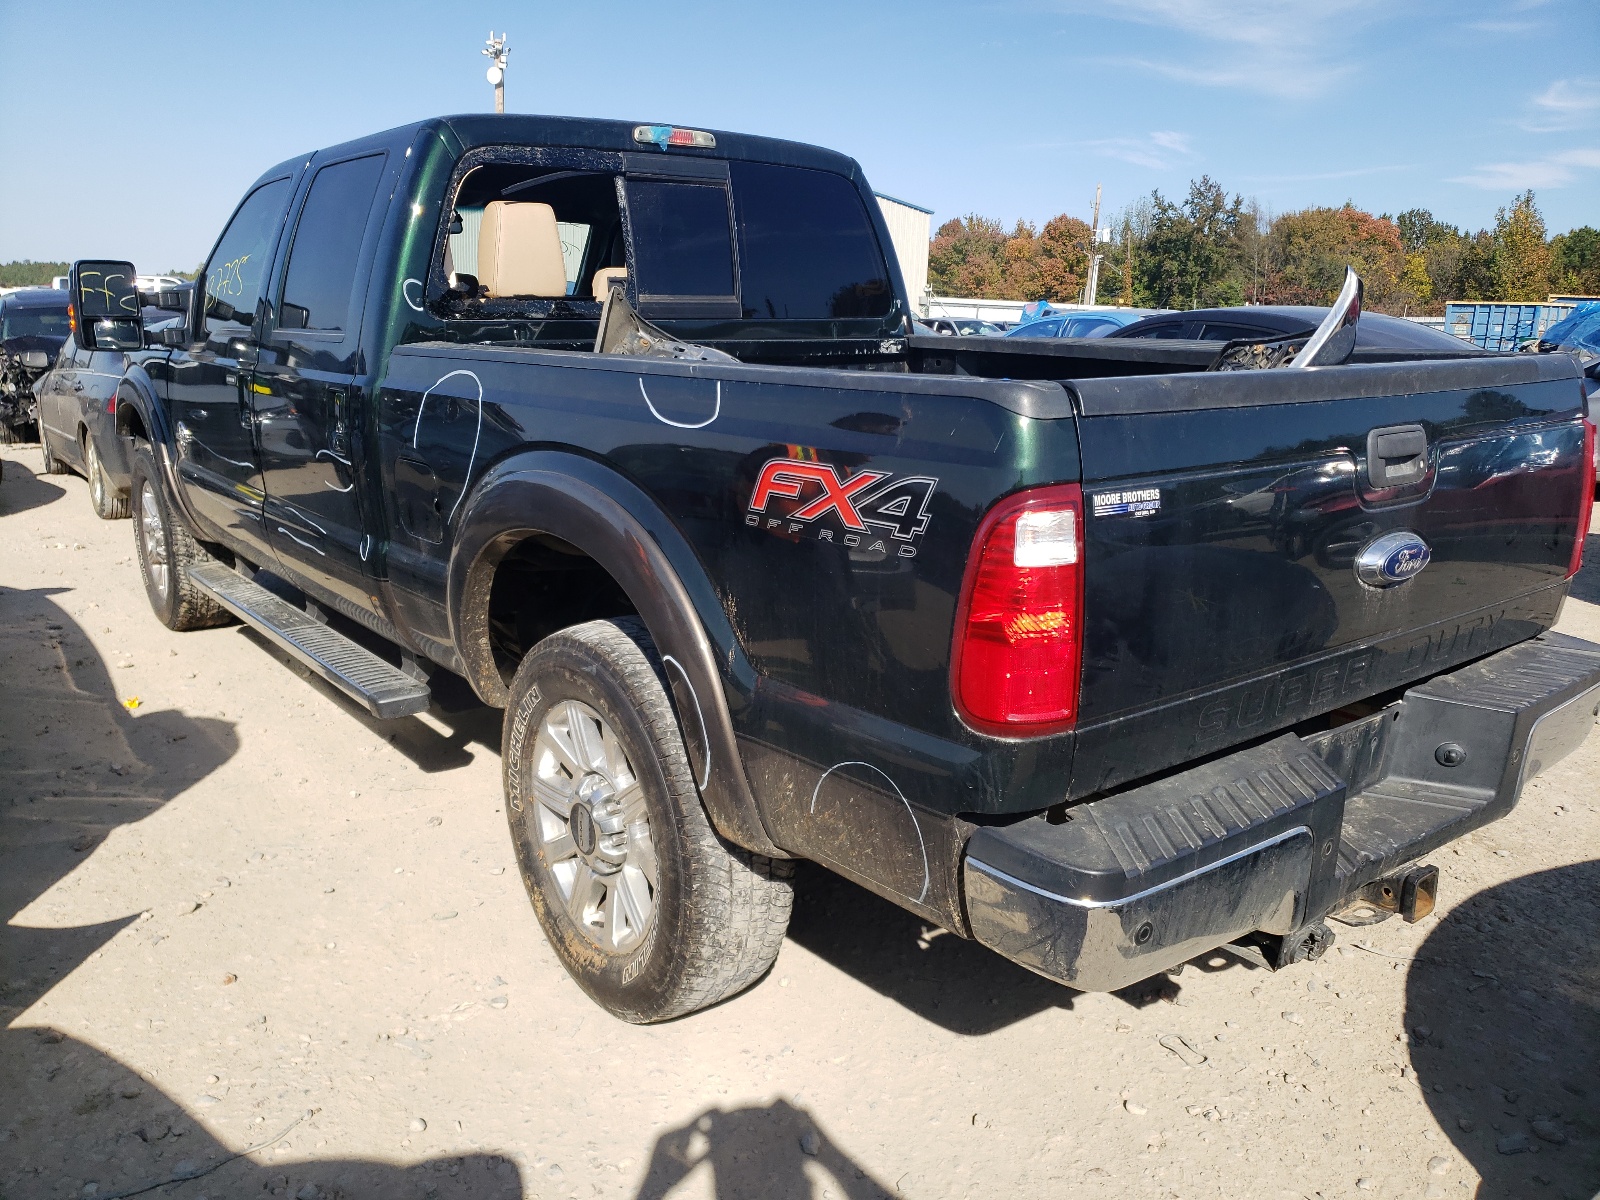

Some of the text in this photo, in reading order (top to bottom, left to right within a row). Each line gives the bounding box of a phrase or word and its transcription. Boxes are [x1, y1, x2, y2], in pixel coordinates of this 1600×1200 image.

[748, 458, 939, 542] FX4
[1094, 489, 1160, 506] MOORE BROTHERS
[1394, 547, 1426, 574] Ford
[1195, 609, 1505, 743] SUPER DUTY
[508, 686, 541, 812] MICHELIN
